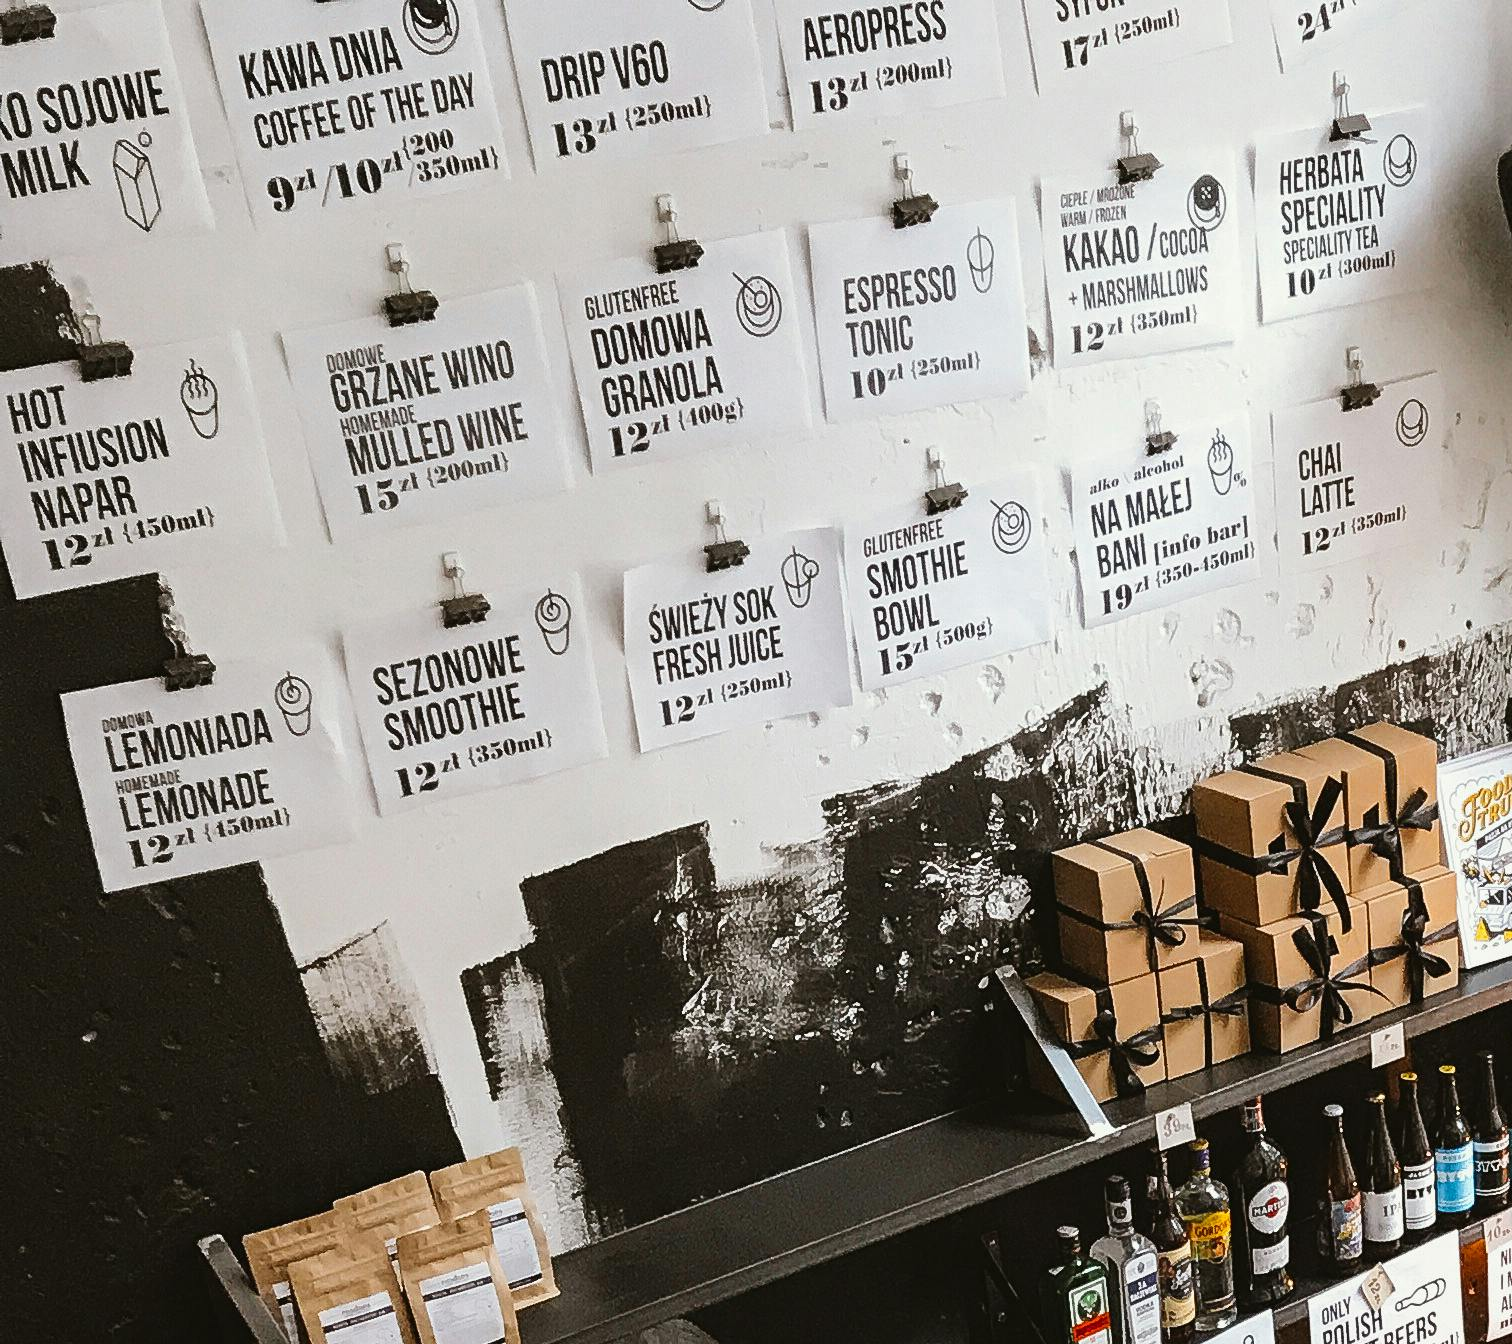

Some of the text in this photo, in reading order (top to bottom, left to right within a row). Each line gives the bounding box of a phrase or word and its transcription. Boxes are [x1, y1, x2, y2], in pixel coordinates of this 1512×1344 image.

[803, 0, 947, 61] AEROPRESS
[239, 27, 403, 100] KAWA DNIA
[540, 39, 670, 104] DRIP V60
[36, 68, 170, 134] SOJOWE
[254, 72, 475, 150] COFFEE OF THE DAY
[0, 138, 91, 198] MILK
[1280, 148, 1364, 195] HERBATA
[1060, 212, 1086, 228] WARM
[1096, 205, 1127, 223] FROZEN
[1281, 184, 1386, 236] SPECIALITY
[1063, 225, 1139, 272] KAKAO
[1283, 224, 1379, 265] SPECIALITY TEA
[584, 280, 679, 320] GLUTENFREE
[843, 265, 957, 314] ESPRESSO
[1082, 265, 1208, 310] MARSHMALLOWS
[326, 344, 386, 373] DOMOWE
[590, 308, 712, 370] DOMOWA
[846, 315, 913, 357] TONIC
[330, 340, 514, 413] GRZANE WINO
[601, 356, 724, 418] GRANOLA
[7, 384, 67, 434] HOT
[340, 404, 418, 437] HOMEMADE
[17, 417, 169, 482] INFIUSION
[344, 402, 529, 476] MULLED WINE
[1299, 442, 1342, 481] CHAI
[30, 475, 137, 530] NAPAR
[1090, 477, 1119, 495] alko
[1134, 455, 1184, 481] alcohol
[1301, 476, 1355, 518] LATTE
[1091, 477, 1192, 538] NA MAŁEJ
[863, 518, 944, 558] GLUTENFREE
[1096, 533, 1147, 579] BANI
[867, 541, 968, 599] SMOTHIE
[649, 585, 778, 644] ŚWIEŻY SOK
[873, 593, 939, 642] BOWL
[373, 635, 526, 706] SEZONOWE
[653, 625, 783, 685] FRESH JUICE
[104, 708, 273, 773] LEMONIADA
[383, 682, 526, 751] SMOOTHIE
[119, 769, 274, 833] LEMONADE
[1322, 1296, 1352, 1325] ONLY
